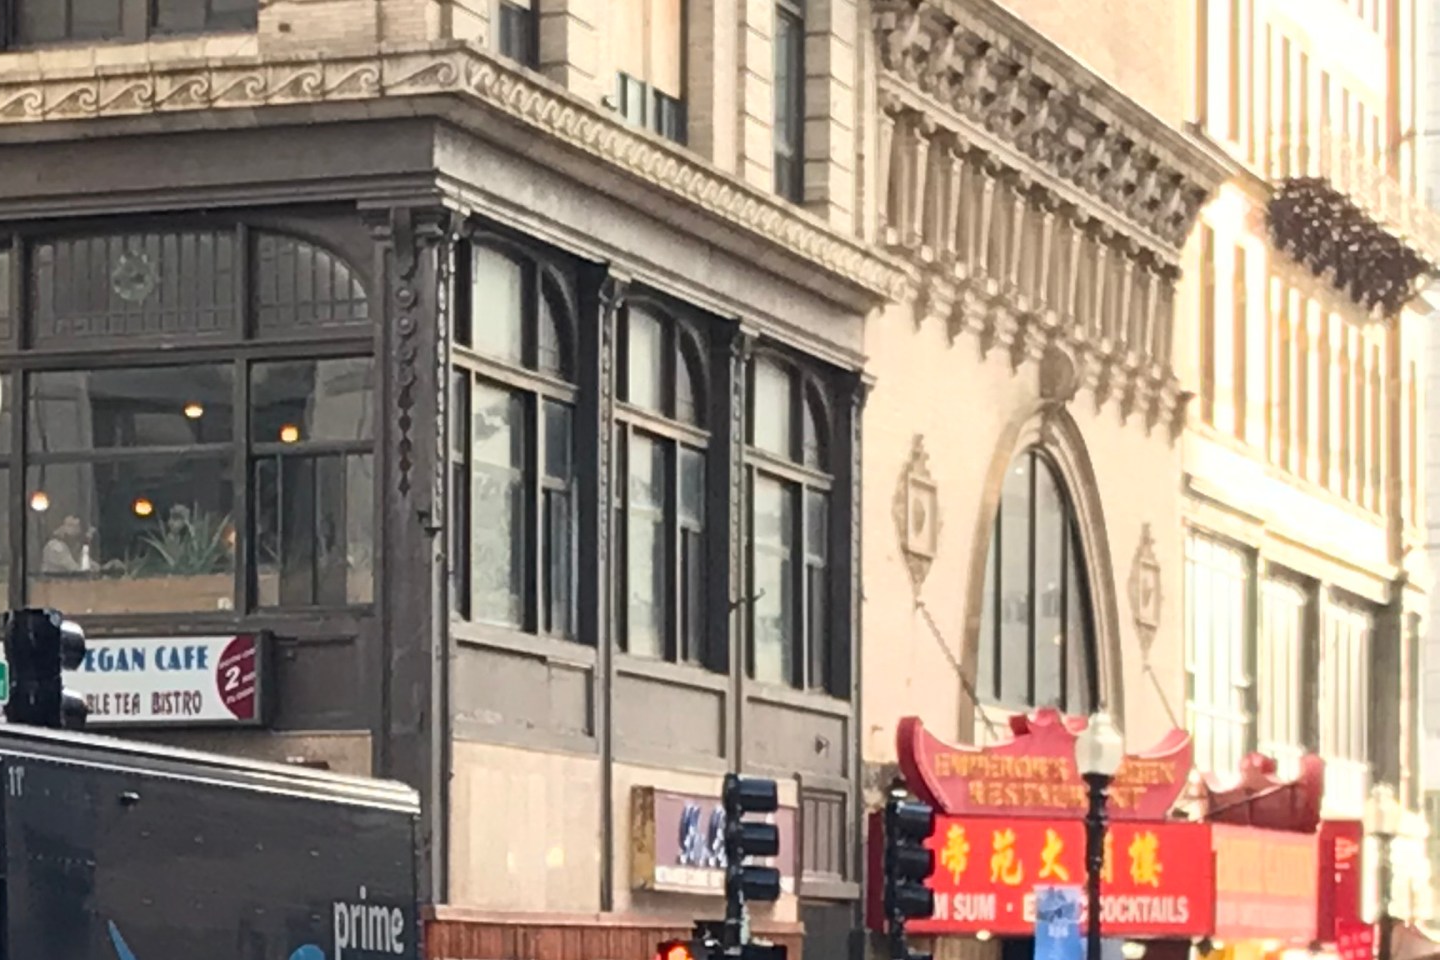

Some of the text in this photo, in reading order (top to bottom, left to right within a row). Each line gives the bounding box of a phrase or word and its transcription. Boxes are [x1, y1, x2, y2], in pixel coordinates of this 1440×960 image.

[84, 647, 146, 672] EGAN
[155, 645, 209, 670] CAFE
[224, 665, 241, 691] 2
[86, 693, 110, 715] BLE
[114, 692, 141, 715] TEA
[151, 690, 202, 716] BISTRO
[968, 780, 1148, 811] RESTAURNT
[942, 823, 1163, 888] 帝苑大樓
[953, 893, 995, 922] SUM
